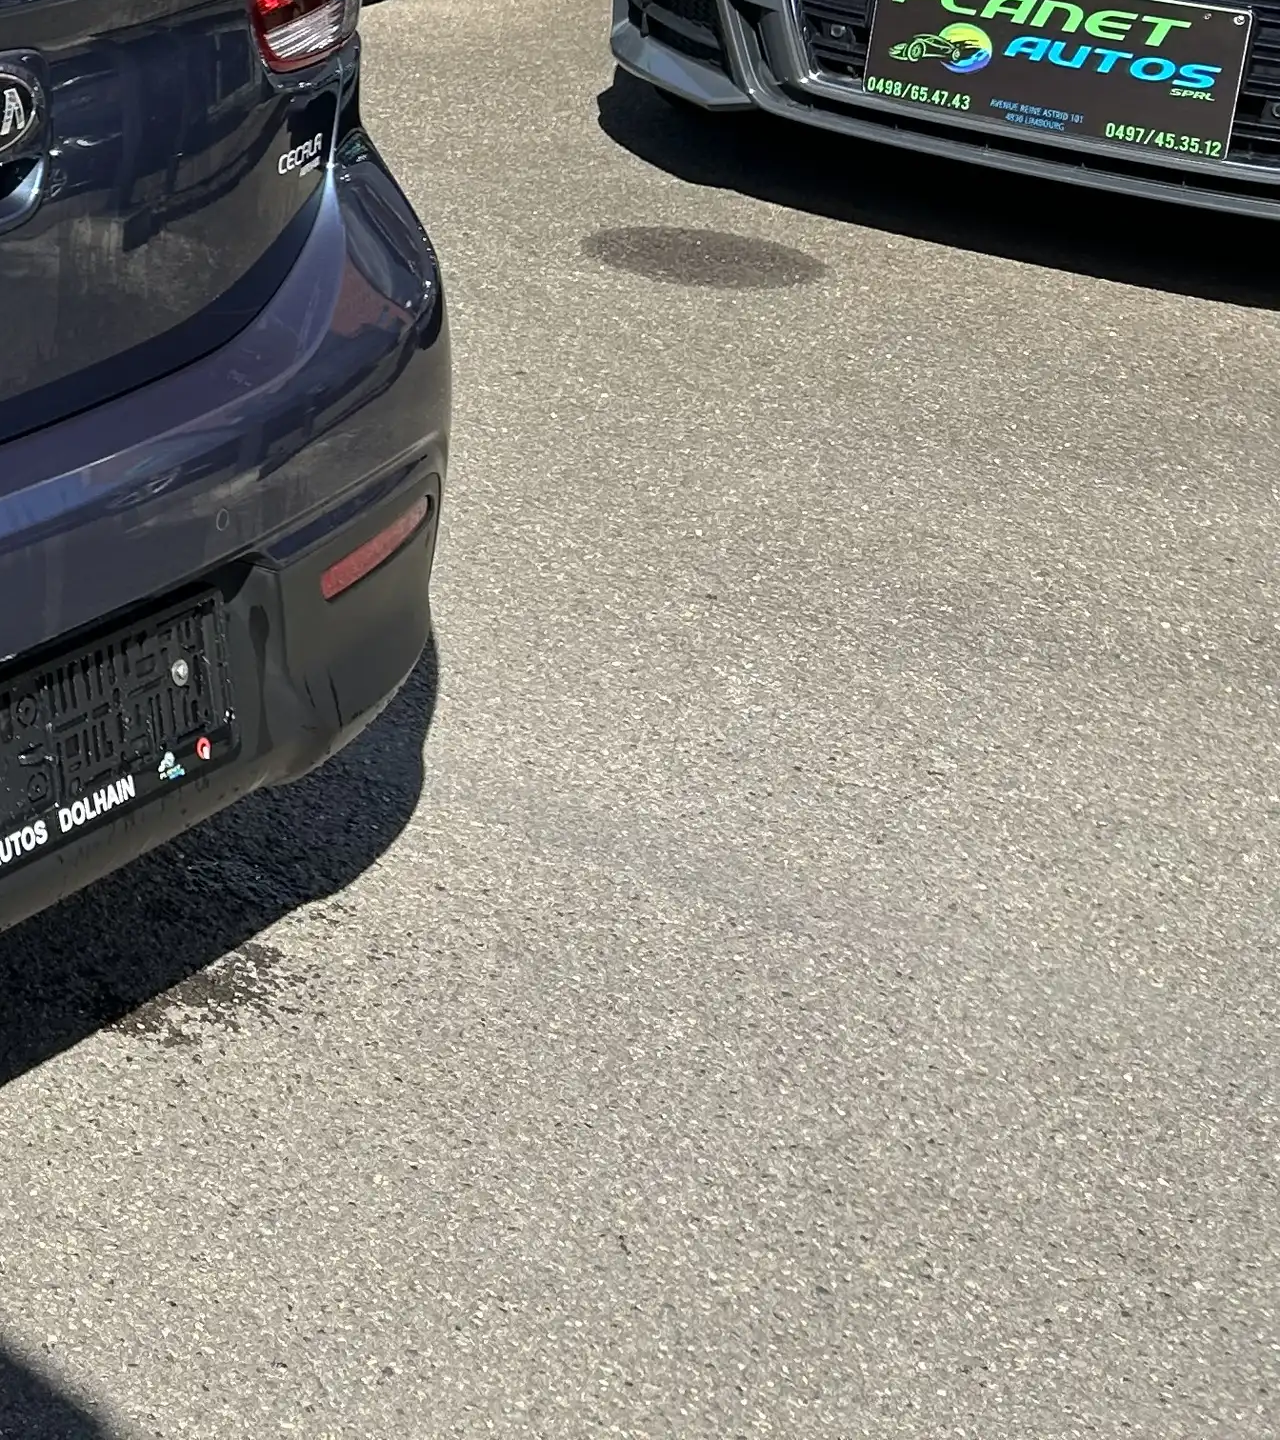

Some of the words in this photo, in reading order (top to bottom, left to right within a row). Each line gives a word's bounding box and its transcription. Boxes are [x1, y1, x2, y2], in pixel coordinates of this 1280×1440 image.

[1001, 35, 1223, 89] AUTOS
[867, 76, 971, 110] 0498/65.47.43
[990, 98, 1019, 111] AVENUE
[1043, 109, 1068, 121] ASTRID
[1168, 87, 1216, 102] SPRL
[1104, 121, 1223, 158] 0497/45.35.12
[58, 774, 137, 833] DOLHAIN
